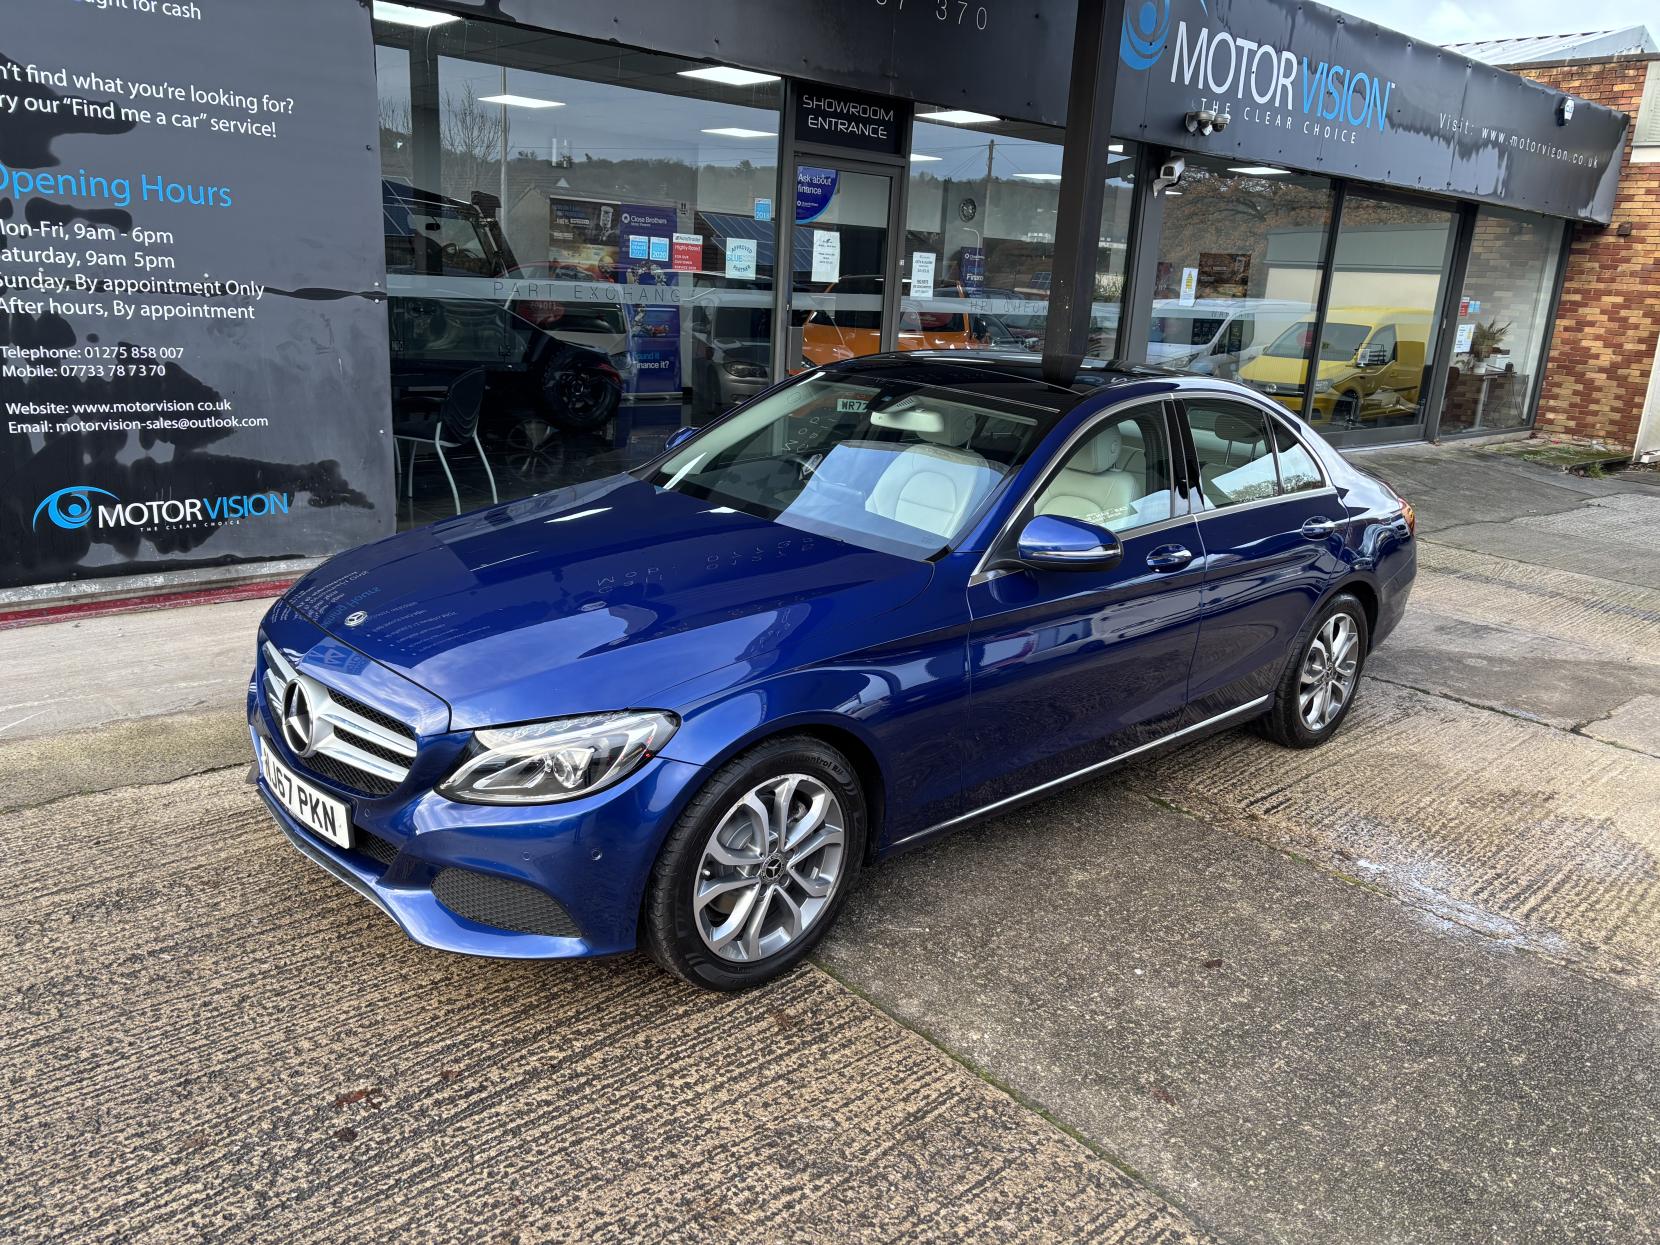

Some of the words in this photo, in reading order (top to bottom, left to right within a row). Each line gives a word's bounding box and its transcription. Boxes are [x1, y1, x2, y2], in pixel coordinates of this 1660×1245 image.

[162, 2, 201, 20] cash
[26, 64, 68, 88] find
[73, 72, 124, 95] what
[128, 82, 186, 100] you're
[190, 86, 258, 114] looking
[261, 94, 294, 115] for?
[24, 97, 60, 113] our
[121, 107, 151, 123] me
[156, 112, 167, 125] a
[211, 115, 277, 138] service!
[802, 94, 894, 121] SHOWROOM
[808, 115, 887, 139] ENTRANCE
[1243, 107, 1293, 129] CLEAR
[1303, 121, 1357, 144] CHOICE
[1439, 112, 1475, 136] Visit:
[0, 162, 131, 207] pening
[141, 174, 232, 208] Hours
[797, 173, 811, 183] Ask
[812, 174, 832, 186] about
[797, 184, 822, 195] finance
[74, 223, 115, 241] 9am
[132, 226, 174, 246] 6pm
[85, 250, 127, 266] 9am
[134, 251, 175, 271] 5pm
[75, 273, 98, 293] By
[103, 276, 221, 299] appointment
[225, 280, 265, 300] Only
[493, 281, 555, 297] PART
[0, 297, 44, 315] After
[50, 297, 108, 318] hours,
[113, 300, 136, 320] By
[140, 302, 256, 321] appointment
[0, 346, 82, 361] Telephone:
[84, 346, 128, 360] 01275
[131, 346, 157, 360] 858
[160, 346, 184, 360] 007
[2, 365, 58, 378] Mobile:
[61, 365, 104, 377] 07733
[636, 361, 659, 369] inance
[6, 402, 70, 416] Website:
[9, 420, 54, 434] Email:
[56, 415, 269, 433] motorvision-sales@outlook.com
[165, 522, 198, 531] CLEAR
[204, 519, 241, 528] CHOICE
[296, 784, 337, 837] PKN
